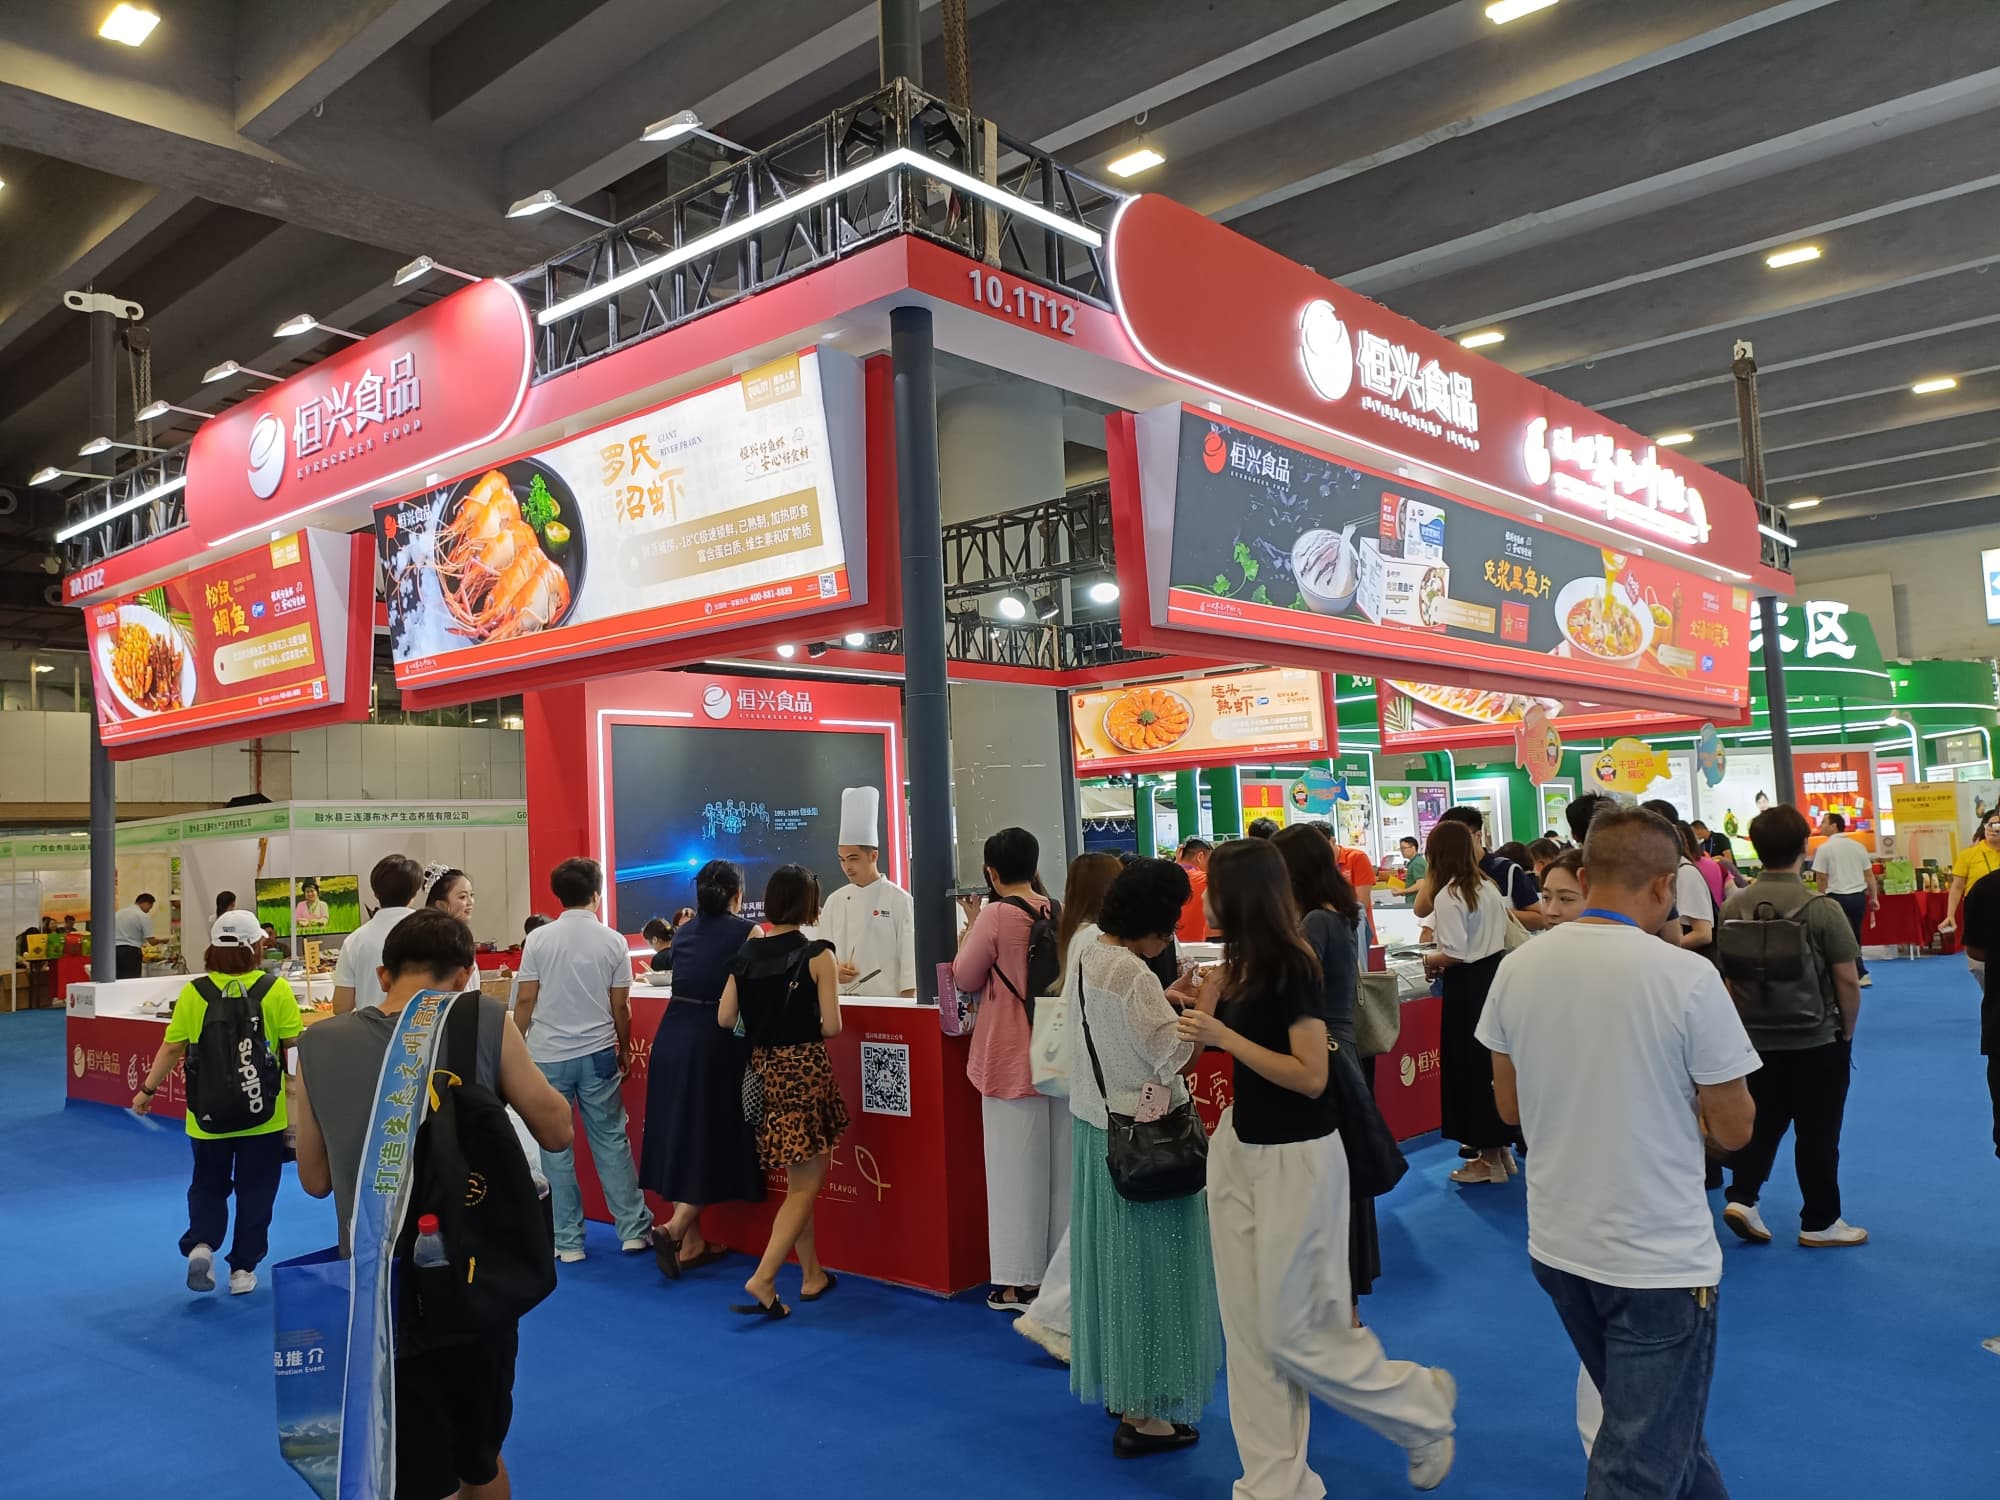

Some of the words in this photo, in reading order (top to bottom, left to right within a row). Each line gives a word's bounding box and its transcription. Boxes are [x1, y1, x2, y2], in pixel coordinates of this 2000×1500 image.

[969, 269, 1076, 336] 10.1T12
[1356, 330, 1479, 433] 恒兴食品
[292, 352, 422, 459] 恒兴食品
[599, 434, 660, 487] 罗氏
[1230, 441, 1290, 484] 恒兴食品
[397, 504, 433, 529] 恒兴食品
[616, 466, 686, 526] 沼虾
[205, 580, 234, 609] 松鼠
[1484, 559, 1552, 600] 免浆黑鱼片
[212, 602, 250, 638] 鲷鱼
[736, 688, 813, 714] 恒兴食品
[1211, 683, 1240, 698] 连头
[87, 1049, 121, 1075] 恒兴食品
[239, 1038, 264, 1114] adidas
[829, 1182, 858, 1196] FLAVOR
